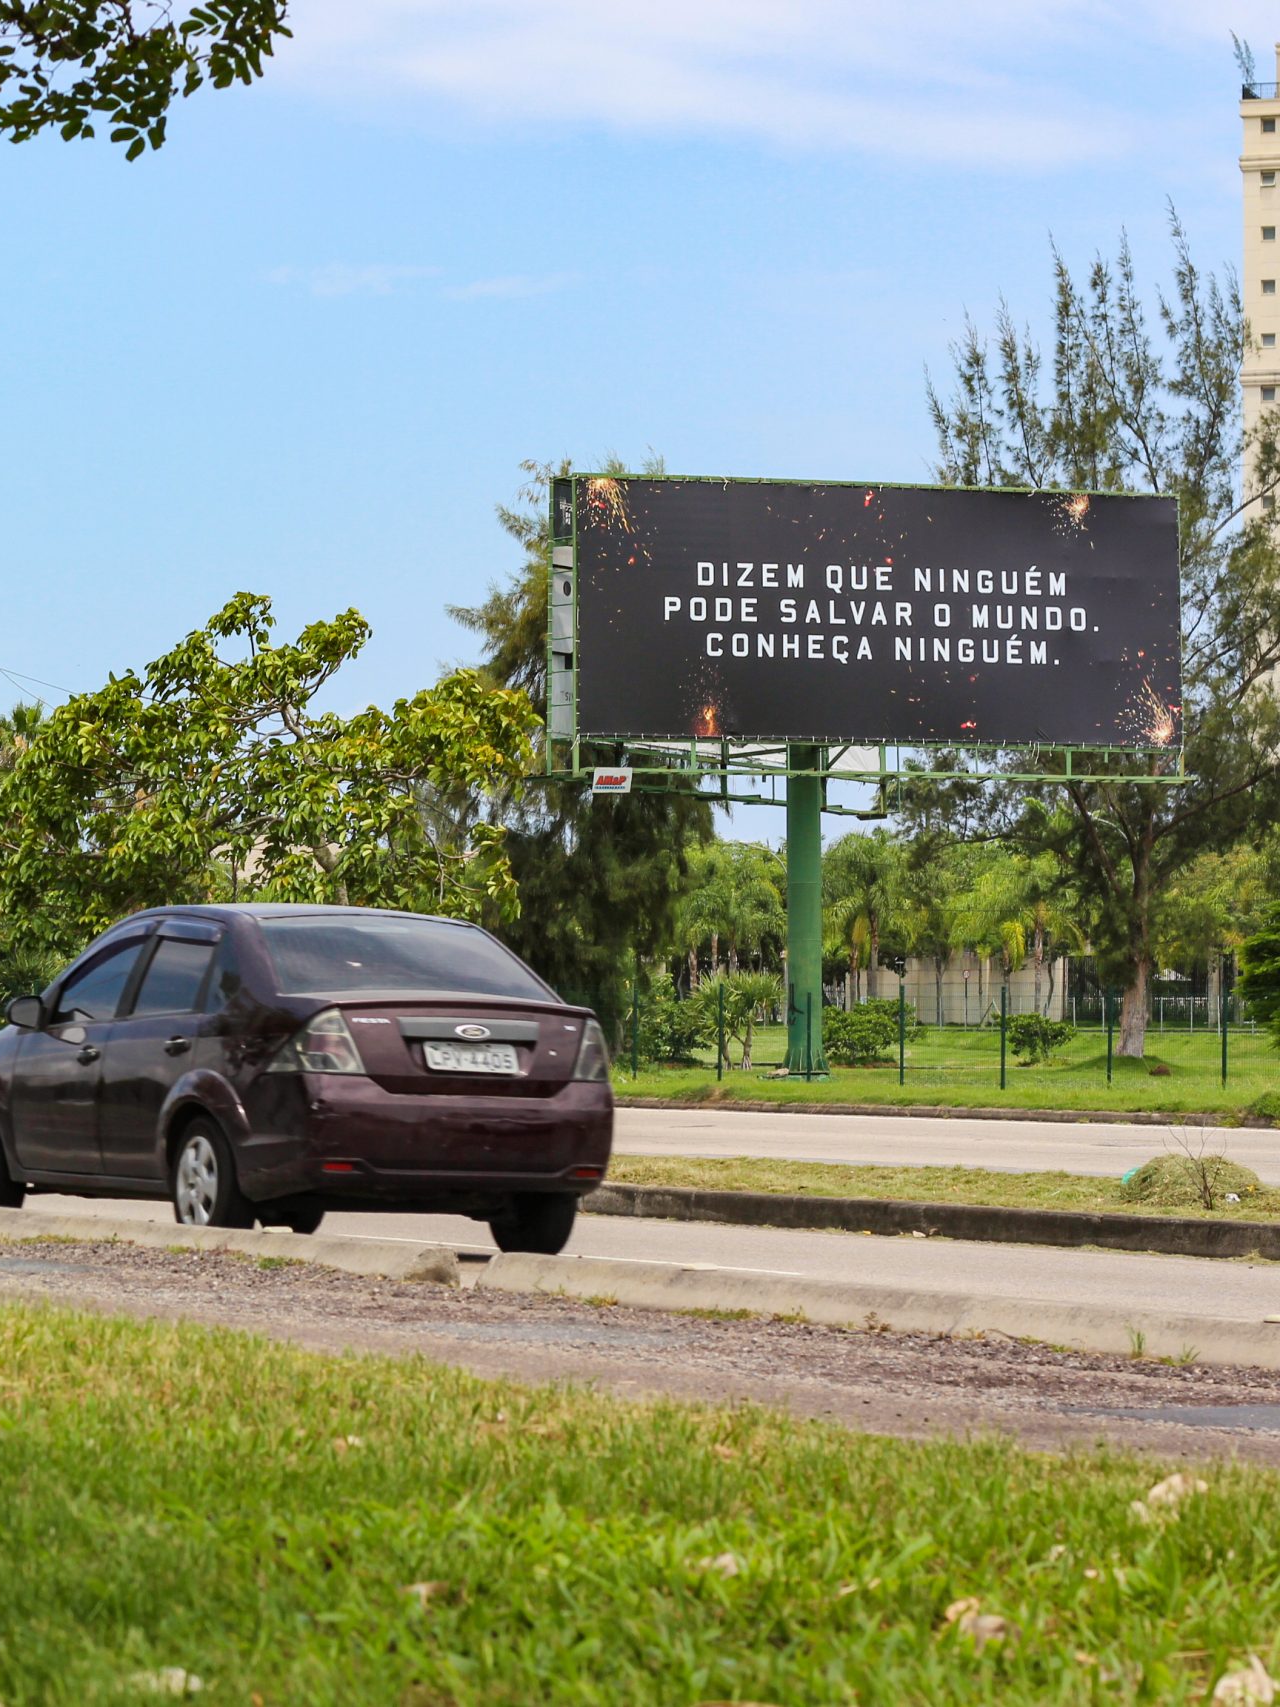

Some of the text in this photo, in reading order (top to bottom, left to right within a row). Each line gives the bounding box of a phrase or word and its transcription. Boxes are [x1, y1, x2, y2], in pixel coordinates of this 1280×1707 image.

[697, 561, 1067, 597] DIZEM QUE NINGUÉM
[664, 596, 1100, 632] PODE SALVAR O MUNDO.
[706, 633, 1061, 665] CONHEÇA NINGUÉM.
